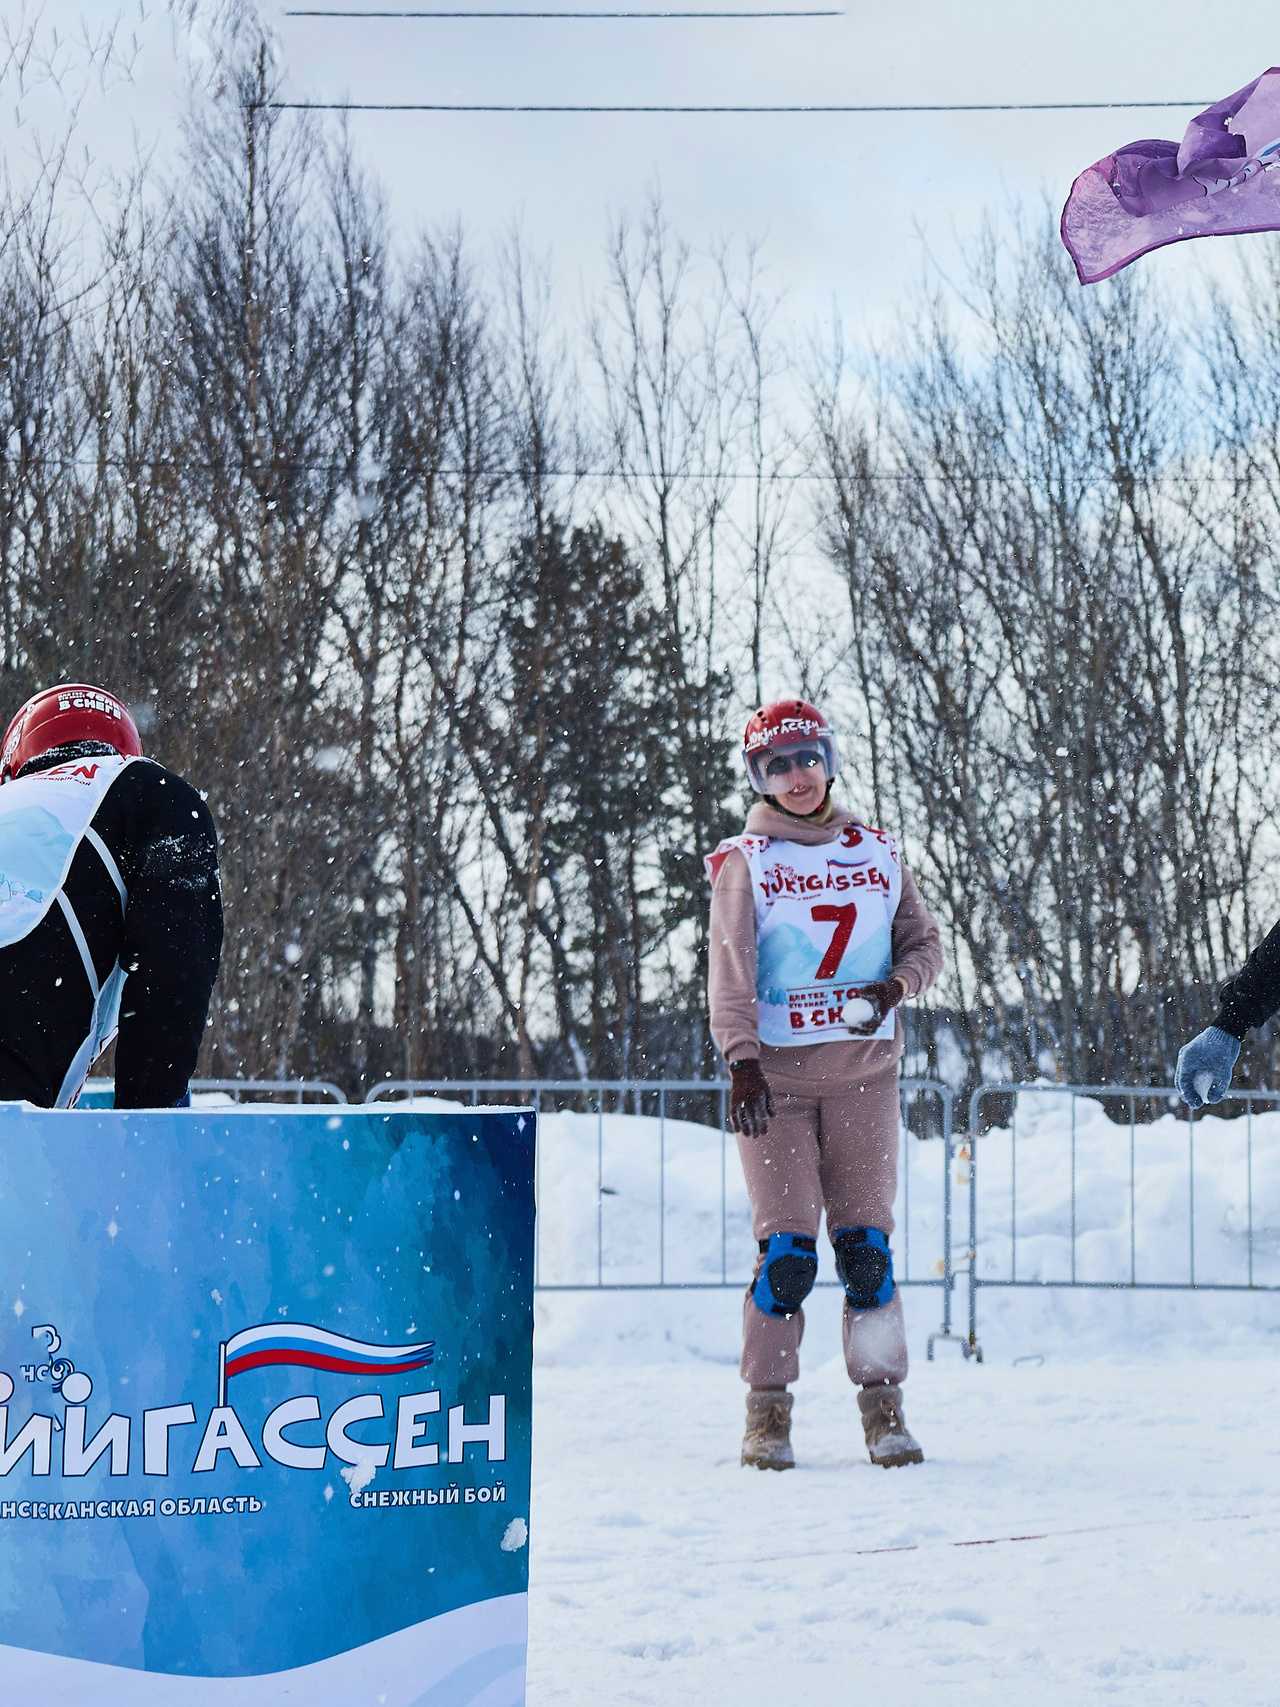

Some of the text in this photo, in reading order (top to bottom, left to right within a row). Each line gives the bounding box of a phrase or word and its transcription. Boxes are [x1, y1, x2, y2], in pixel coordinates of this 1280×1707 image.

[59, 698, 122, 720] В СНЕГЕ
[759, 866, 891, 899] YUKIGASSEN
[810, 902, 858, 980] 7
[832, 987, 861, 1003] ТО
[790, 1011, 805, 1029] В
[0, 1371, 507, 1478] ИИГАССЕН
[160, 1496, 263, 1516] ОБЛАСТЬ
[350, 1480, 507, 1509] СНЕЖНЫЙ БОЙ
